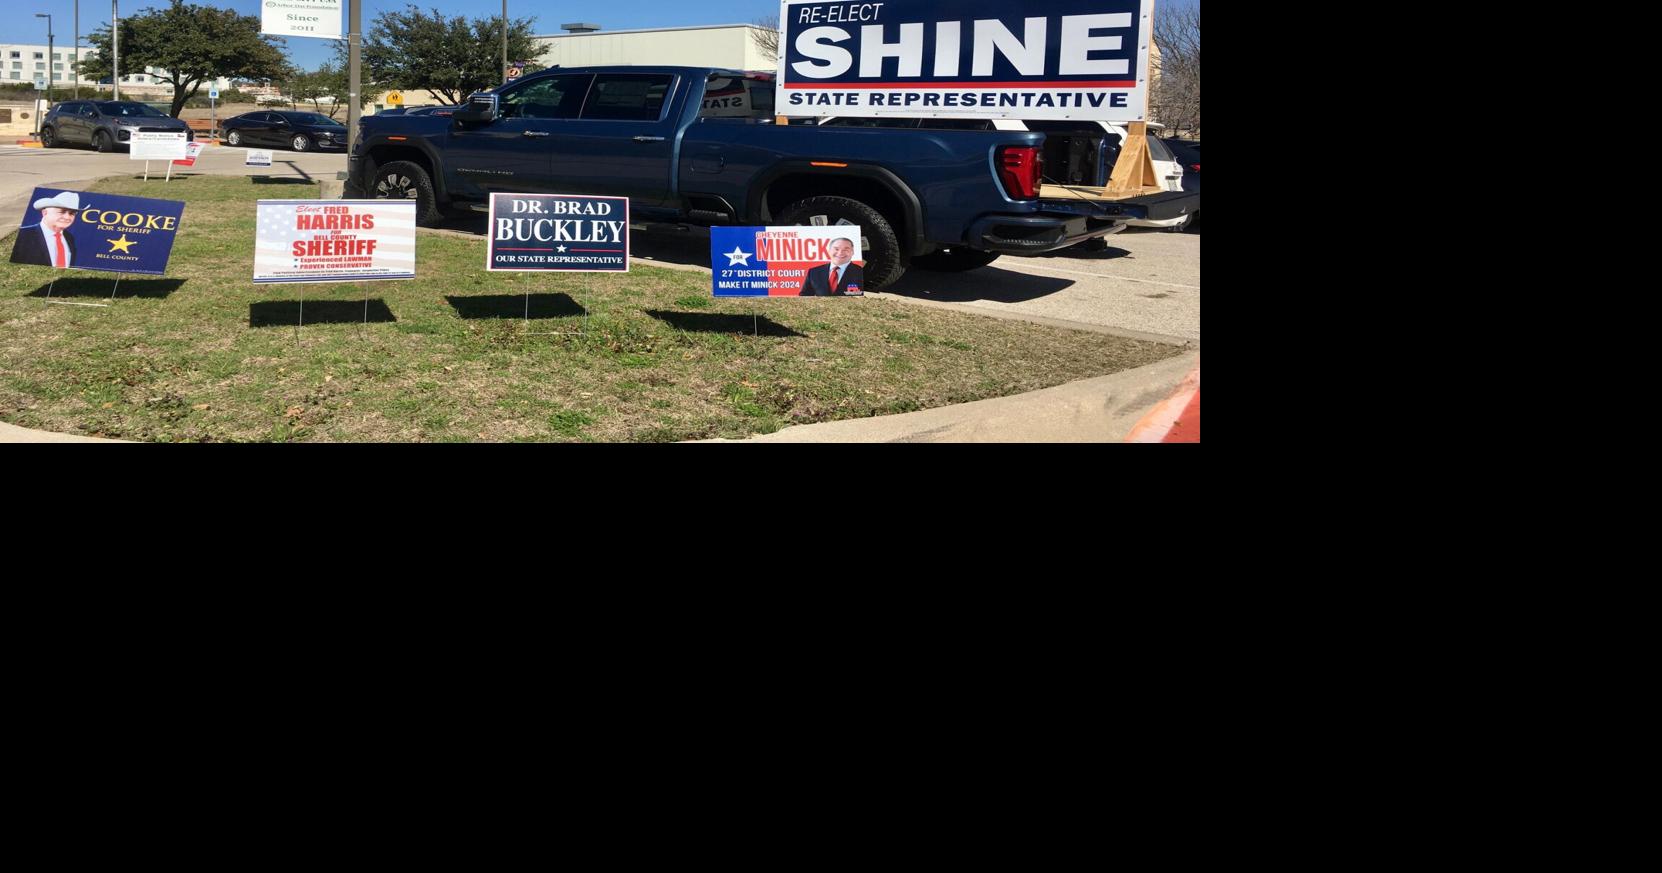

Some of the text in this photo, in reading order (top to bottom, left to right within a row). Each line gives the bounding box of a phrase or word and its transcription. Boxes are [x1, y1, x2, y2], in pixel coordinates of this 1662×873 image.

[286, 14, 319, 22] Since
[799, 3, 883, 24] RE-ELECT
[791, 12, 1132, 79] SHINE
[789, 92, 1128, 108] STATE REPRESENTATIVE
[295, 205, 349, 214] Elect FRED
[512, 199, 611, 216] DR. BRAD
[81, 209, 176, 230] COOKE
[297, 214, 374, 230] HARRIS
[116, 226, 151, 234] SHERIFF
[495, 217, 626, 243] BUCKLEY
[292, 239, 377, 257] SHERIFF
[756, 238, 831, 261] MINICK
[496, 255, 623, 264] OUR STATE REPRESENTATIVE
[718, 281, 801, 289] MAKE IT MINICK 2024
